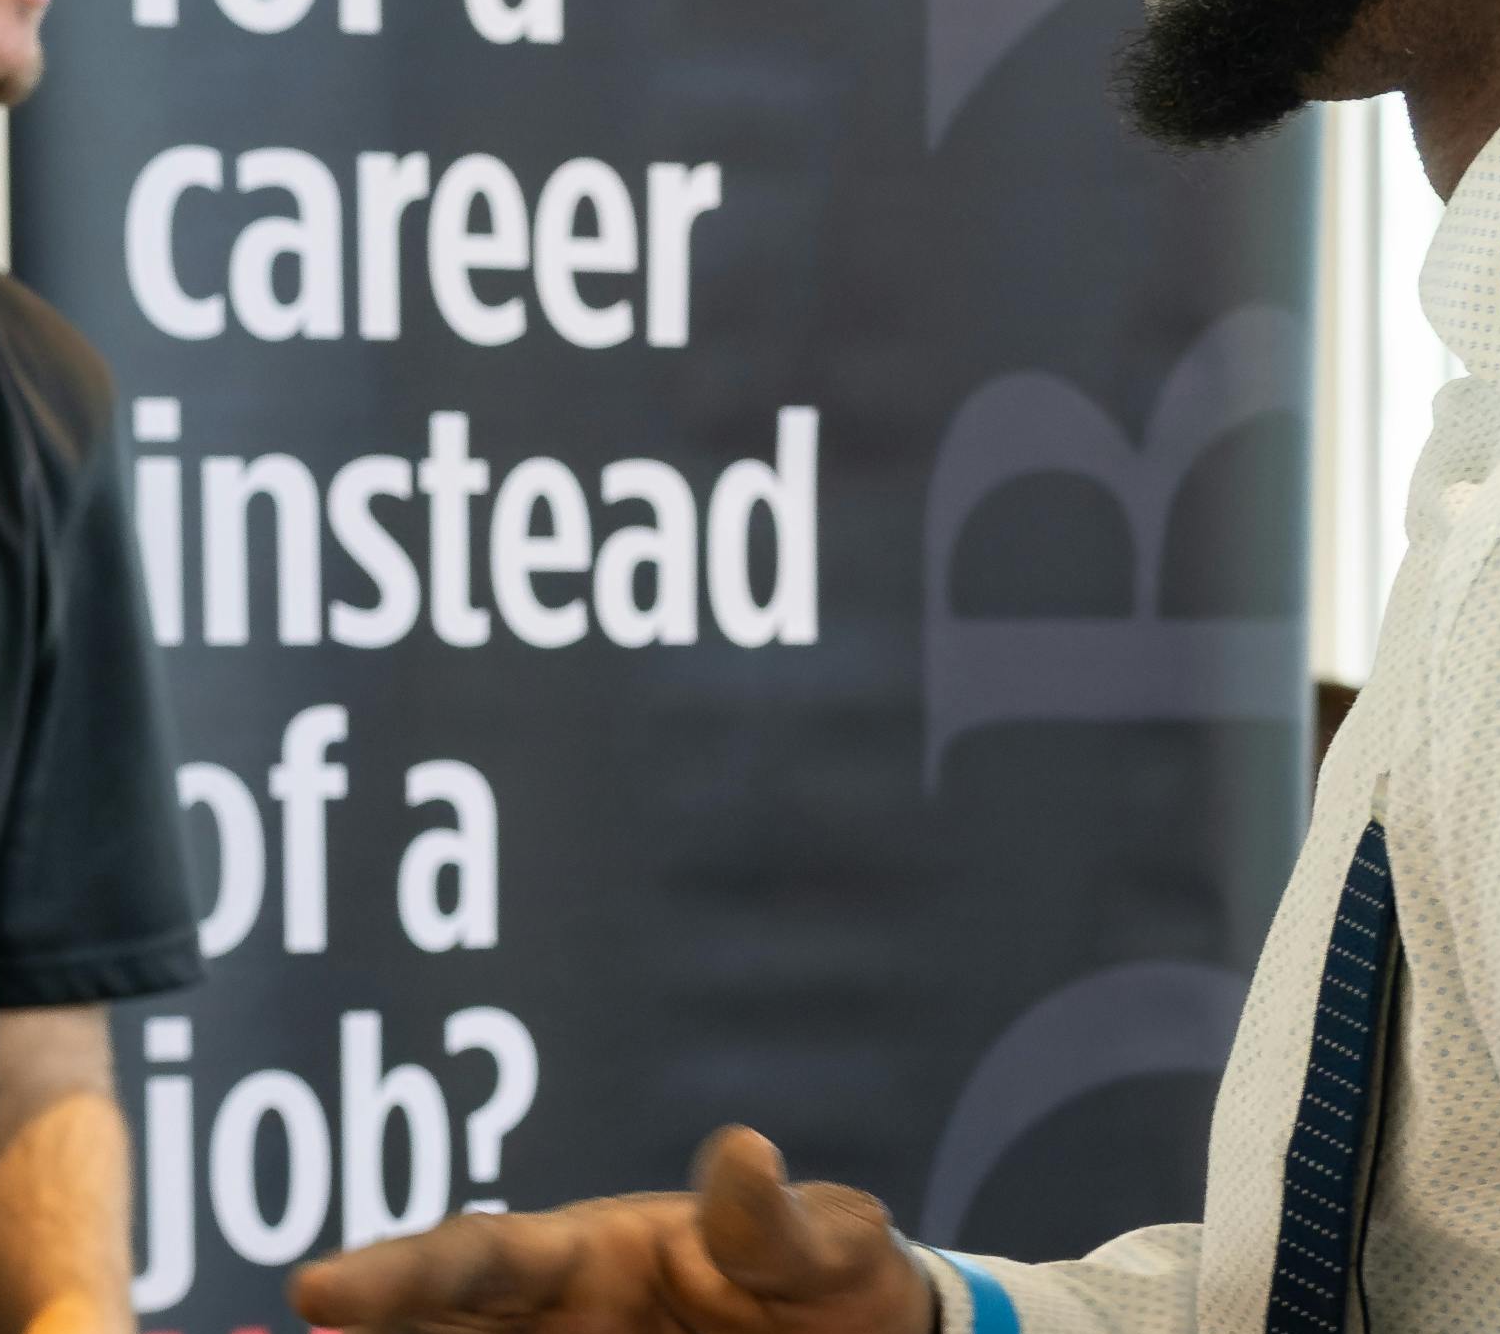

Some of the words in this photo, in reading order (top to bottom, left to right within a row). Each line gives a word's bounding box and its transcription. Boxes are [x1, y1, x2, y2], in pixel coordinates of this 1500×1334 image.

[124, 143, 722, 348] career
[131, 397, 819, 649] instead
[175, 703, 349, 958] of
[396, 757, 500, 955] a
[132, 1005, 539, 1314] job?
